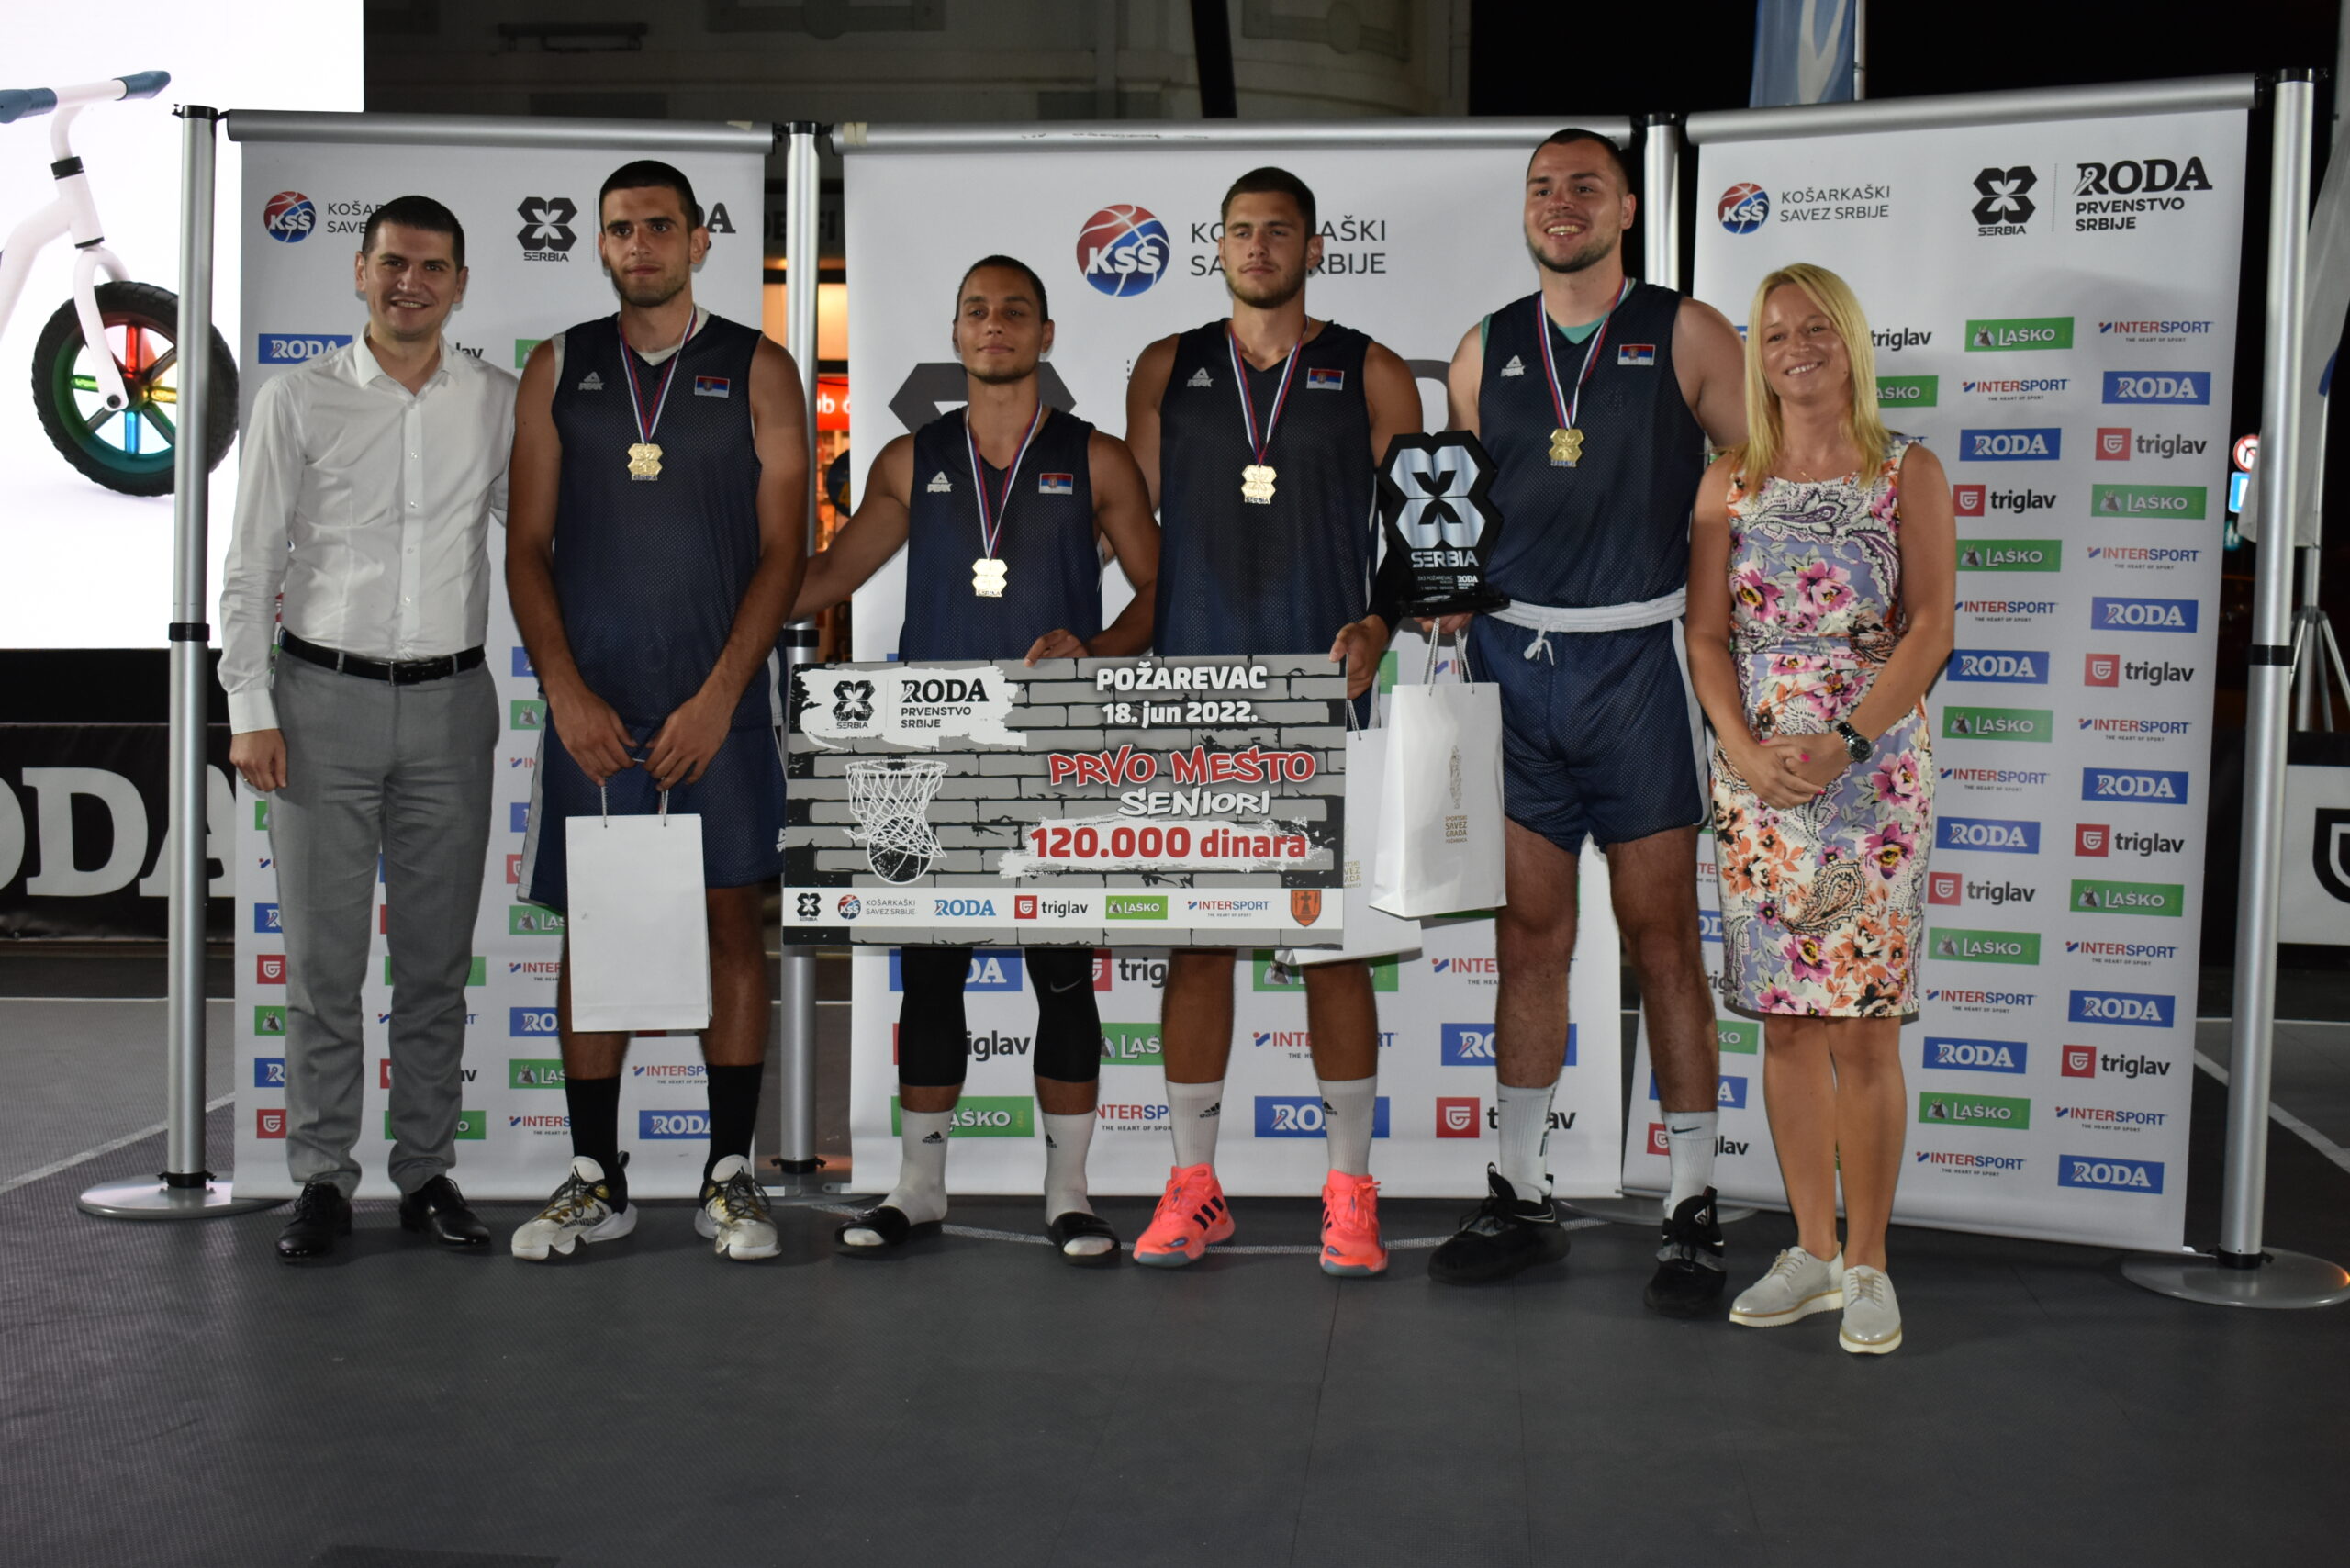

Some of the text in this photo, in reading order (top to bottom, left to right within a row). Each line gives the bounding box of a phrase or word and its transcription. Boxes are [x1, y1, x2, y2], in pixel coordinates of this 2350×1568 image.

[2073, 156, 2212, 196] RODA
[1782, 184, 1890, 204] KOŠARKAŠKI
[328, 200, 383, 216] KOŠA
[1722, 205, 1764, 222] KSS
[1780, 205, 1889, 222] SAVEZ SRBIJE
[2076, 197, 2184, 214] PRVENSTVO
[270, 215, 312, 230] KSS
[327, 221, 367, 233] SAVE
[1978, 226, 2026, 236] SERBIA
[2076, 217, 2136, 231] SRBIJE
[523, 252, 570, 263] SERBIA
[1089, 246, 1161, 274] KSS
[1310, 253, 1387, 274] RBIJE
[2114, 321, 2210, 333] INTERSPORT
[1872, 328, 1931, 351] triglav
[1998, 328, 2054, 346] LAŠKO
[1876, 386, 1920, 399] AŠKO
[1977, 379, 2067, 392] INTERSPORT
[2115, 377, 2198, 398] RODA
[1974, 434, 2048, 455] RODA
[2136, 434, 2207, 459] triglav
[1990, 489, 2056, 514] triglav
[2127, 493, 2188, 512] LAŠKO
[1411, 551, 1480, 567] SERBIA
[1986, 547, 2042, 566] LAŠKO
[2103, 547, 2199, 562] INTERSPORT
[1964, 601, 2055, 613] INTERSPORT
[2104, 603, 2186, 626] RODA
[1960, 655, 2036, 678] RODA
[2125, 661, 2194, 686] triglav
[1097, 661, 1268, 691] POŽAREVAC
[900, 678, 990, 703] RODA
[901, 707, 972, 717] PRVENSTVO
[1102, 700, 1258, 729] 18. jun 2022.
[836, 722, 868, 730] SERBIA
[901, 719, 941, 728] SRBIJE
[1975, 715, 2034, 734] LAŠKO
[2094, 719, 2189, 734] INTERSPORT
[1047, 744, 1316, 787] PRVO MESTO
[1953, 768, 2046, 784] INTERSPORT
[2096, 774, 2176, 798] RODA
[1117, 787, 1270, 816] SENIORI
[1445, 821, 1468, 830] SAVEZ
[1445, 829, 1468, 837] GRADA
[1030, 826, 1307, 858] 120.000 dinara
[1949, 823, 2027, 847] RODA
[2114, 832, 2185, 857] triglav
[1343, 867, 1361, 875] VEZ
[866, 898, 916, 907] KOŠARKAŠKI
[1966, 881, 2035, 906] triglav
[2105, 890, 2165, 908] LAŠKO
[839, 904, 860, 913] KSS
[866, 908, 915, 916] SAVEZ SRBIJE
[933, 899, 997, 917] RODA
[1041, 900, 1088, 918] triglav
[1123, 899, 1160, 913] LAŠKO
[1198, 900, 1270, 911] INTERSPORT
[1963, 938, 2021, 957] LAŠKO
[2081, 941, 2177, 958] INTERSPORT
[1119, 957, 1168, 989] trig
[1941, 990, 2033, 1005] INTERSPORT
[2084, 996, 2162, 1021] RODA
[967, 1030, 1031, 1061] iglav
[1121, 1034, 1161, 1058] LAŠ
[1935, 1043, 2014, 1068] RODA
[646, 1066, 709, 1076] INTERSP
[2101, 1053, 2171, 1079] triglav
[950, 1108, 1011, 1131] AŠKO
[1953, 1102, 2011, 1121] LAŠKO
[2070, 1107, 2165, 1126] INTERSPORT
[523, 1116, 570, 1127] INTERS
[1930, 1152, 2024, 1170] INTERSPORT
[2072, 1161, 2151, 1187] RODA
